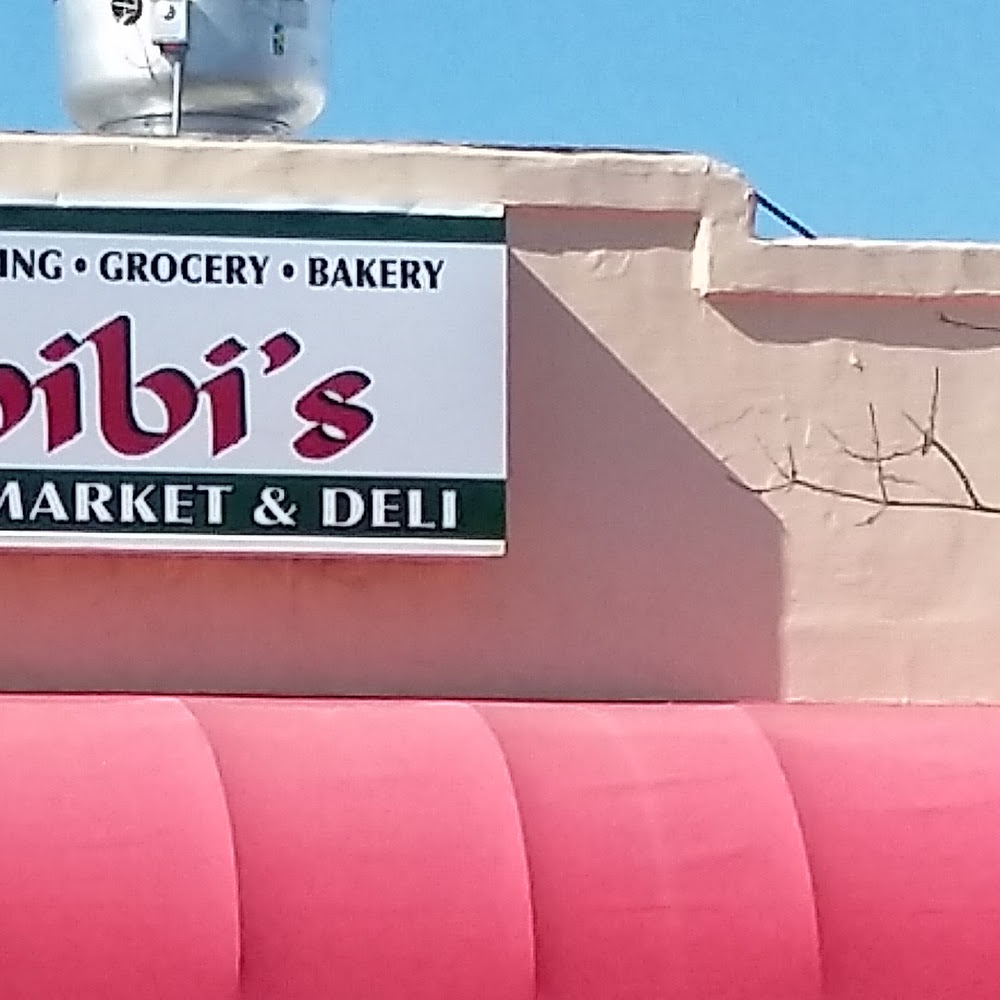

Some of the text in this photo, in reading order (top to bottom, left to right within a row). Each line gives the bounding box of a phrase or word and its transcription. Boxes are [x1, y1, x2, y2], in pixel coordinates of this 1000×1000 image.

[99, 250, 270, 285] GROCERY
[308, 257, 445, 290] BAKERY
[253, 486, 297, 526] &
[322, 488, 458, 529] DELI
